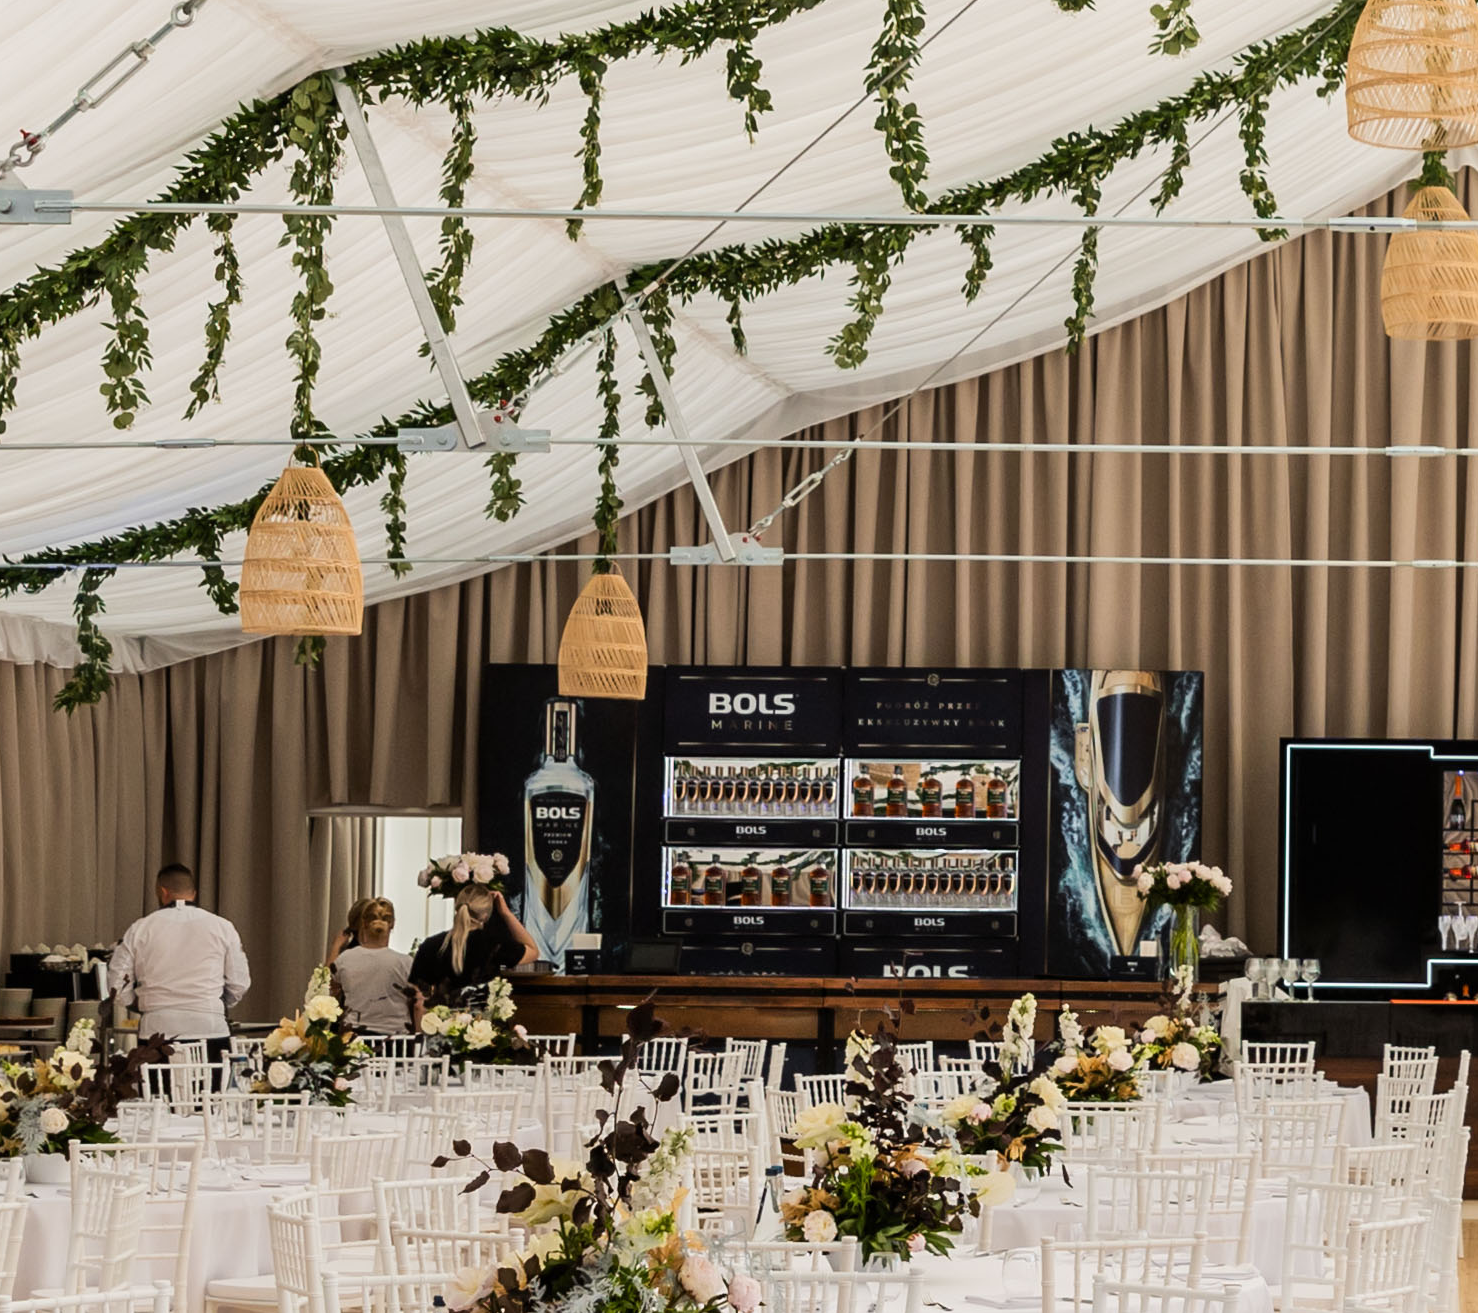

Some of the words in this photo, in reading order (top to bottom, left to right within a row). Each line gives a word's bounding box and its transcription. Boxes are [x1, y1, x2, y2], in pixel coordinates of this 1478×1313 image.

[708, 692, 796, 715] BOLS
[711, 719, 793, 731] MARINE
[535, 806, 582, 820] BOLS
[735, 825, 767, 835] BOLS
[915, 827, 947, 836] BOLS
[733, 915, 765, 925] BOLS
[913, 917, 946, 927] BOLS
